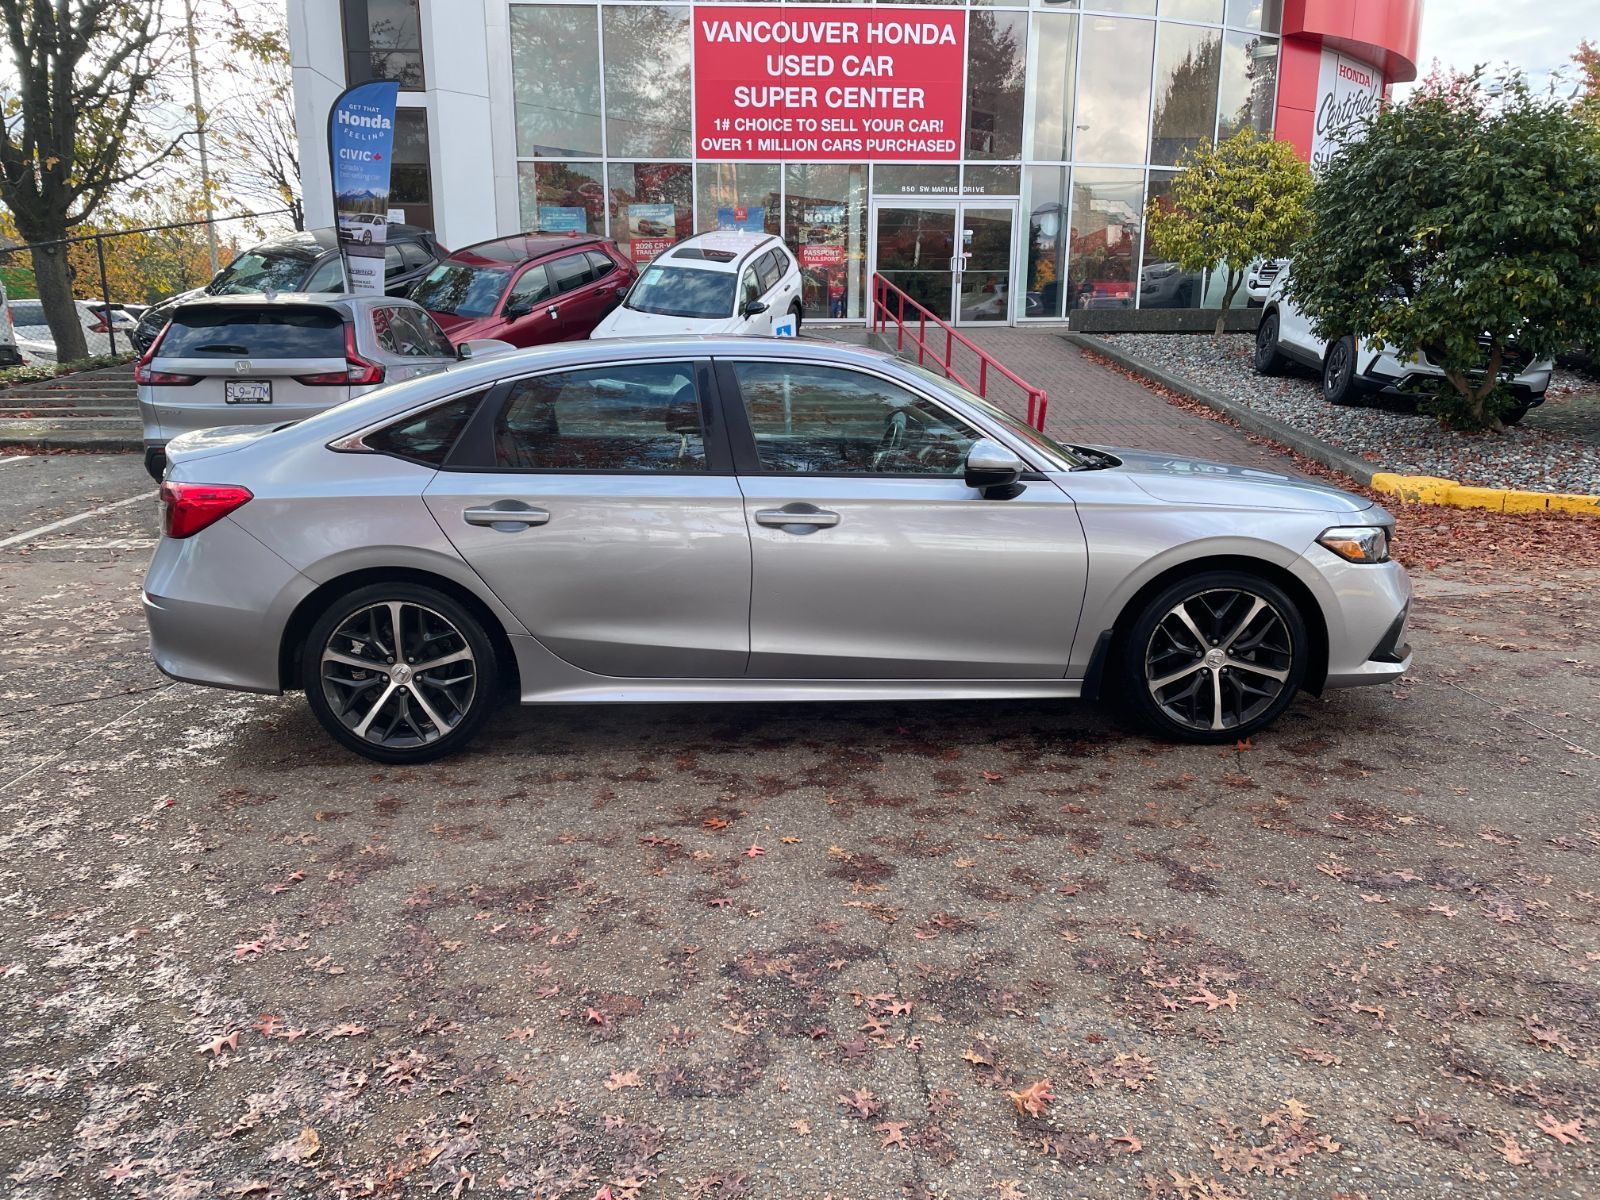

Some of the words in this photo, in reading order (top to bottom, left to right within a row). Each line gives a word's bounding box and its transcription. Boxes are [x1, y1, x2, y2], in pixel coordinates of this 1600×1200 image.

[702, 20, 859, 44] VANCOUVER
[867, 22, 957, 45] HONDA
[766, 55, 834, 77] USED
[841, 55, 894, 77] CAR
[1339, 64, 1371, 88] HONDA
[733, 86, 818, 108] SUPER
[824, 87, 925, 109] CENTER
[363, 105, 380, 113] THAT
[1316, 84, 1378, 136] Certified
[338, 110, 391, 129] Honda
[714, 118, 730, 132] 1#
[734, 118, 793, 132] CHOICE
[796, 118, 817, 132] TO
[820, 118, 858, 132] SELL
[862, 118, 905, 132] YOUR
[908, 118, 944, 133] CAR!
[343, 128, 385, 140] FEELING
[701, 138, 742, 151] OVER
[746, 138, 753, 151] 1
[758, 138, 818, 152] MILLION
[821, 138, 862, 152] CARS
[866, 139, 956, 153] PURCHASED
[339, 148, 372, 161] CIVIC
[803, 213, 841, 223] MORE
[803, 249, 840, 257] PASSPORT
